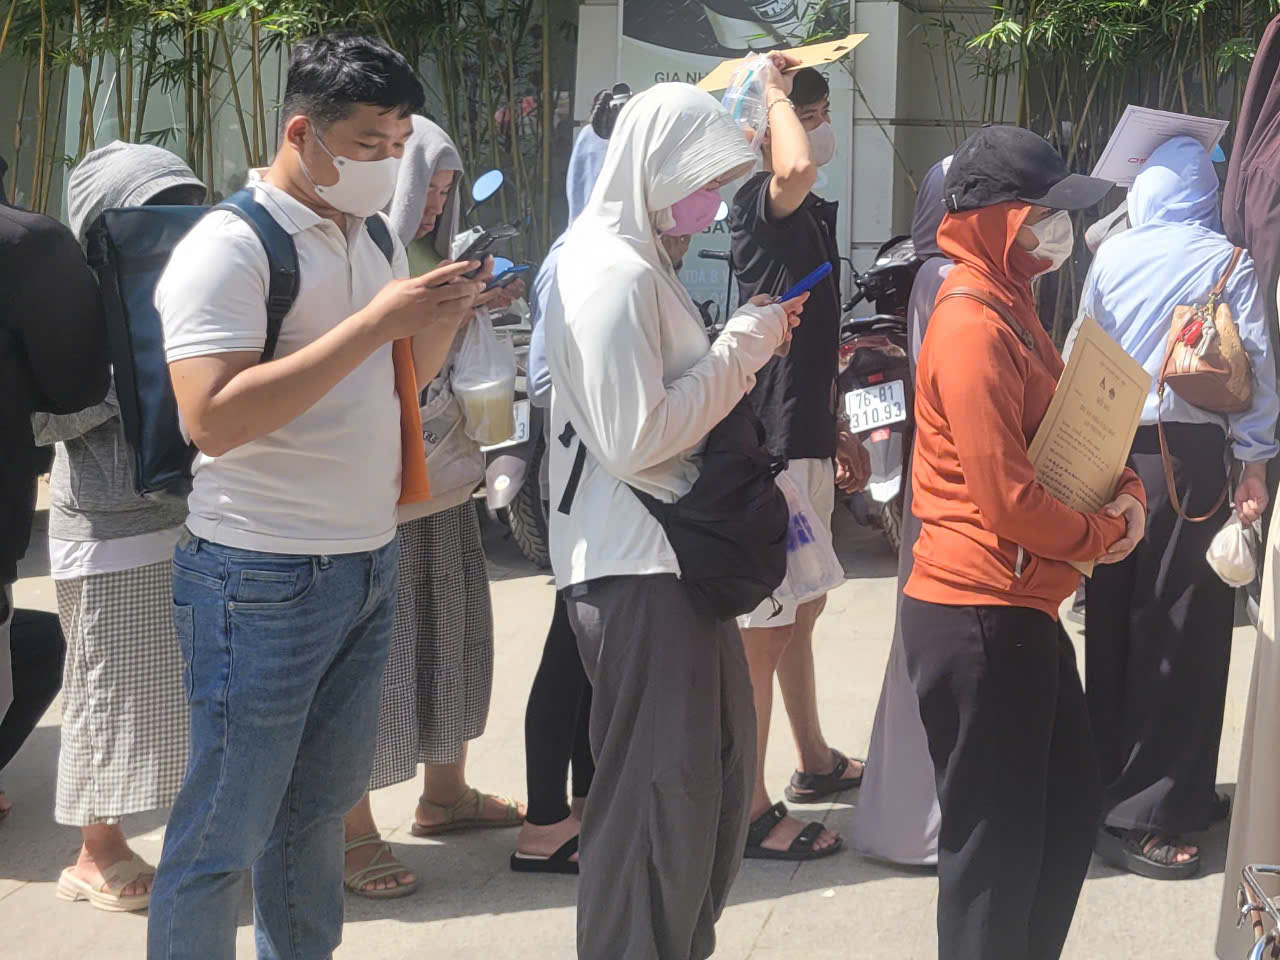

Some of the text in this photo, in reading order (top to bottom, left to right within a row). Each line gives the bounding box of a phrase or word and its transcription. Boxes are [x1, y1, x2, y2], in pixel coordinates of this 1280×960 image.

[654, 71, 681, 84] GIA
[855, 385, 894, 410] 76-B1
[852, 401, 902, 428] 310.93
